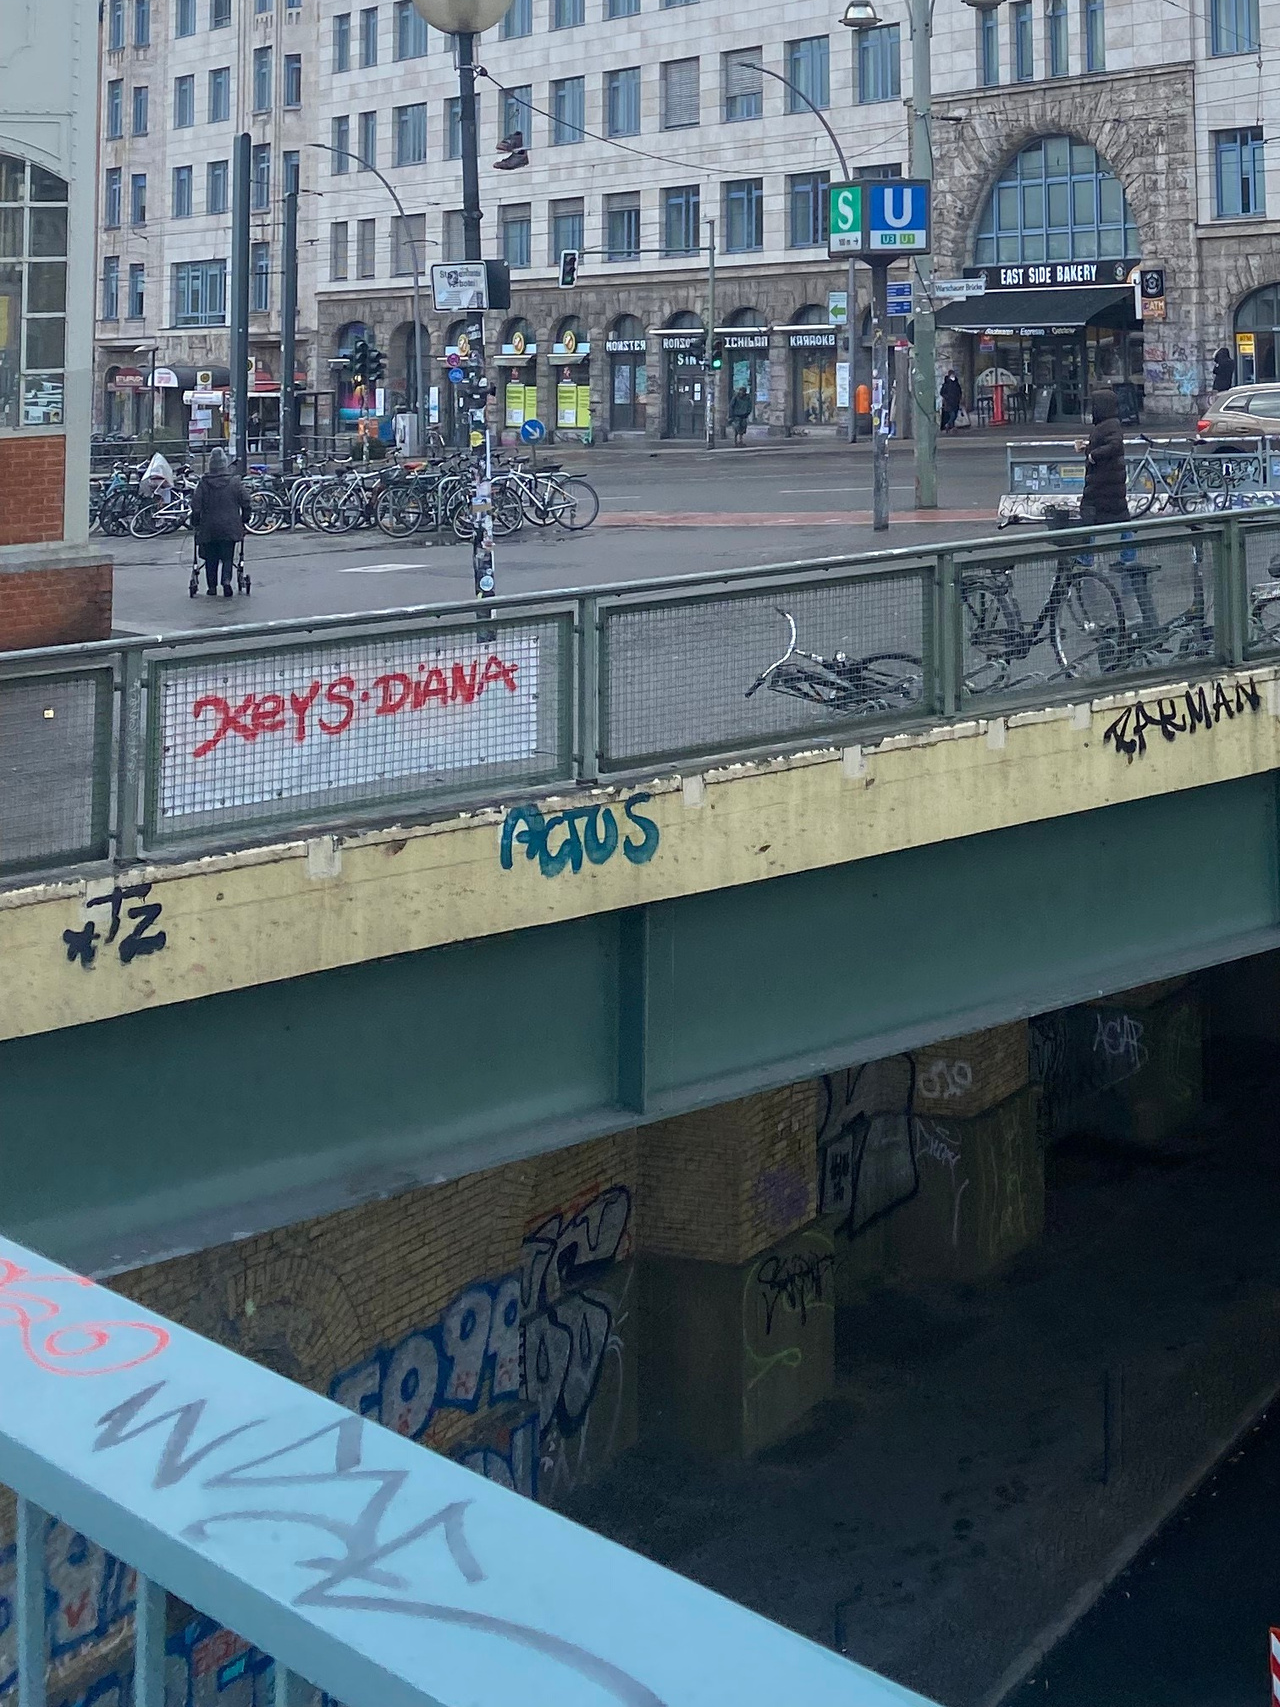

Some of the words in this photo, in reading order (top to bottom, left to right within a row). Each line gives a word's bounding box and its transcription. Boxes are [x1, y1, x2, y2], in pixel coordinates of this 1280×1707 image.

[837, 190, 854, 231] S
[883, 187, 912, 228] U
[882, 235, 894, 244] U3
[901, 235, 913, 244] U1
[1000, 268, 1024, 285] EAST
[1028, 266, 1051, 284] SIDE
[1057, 264, 1098, 282] BAKERY
[935, 283, 965, 292] Warschauer
[965, 282, 983, 291] Brücke
